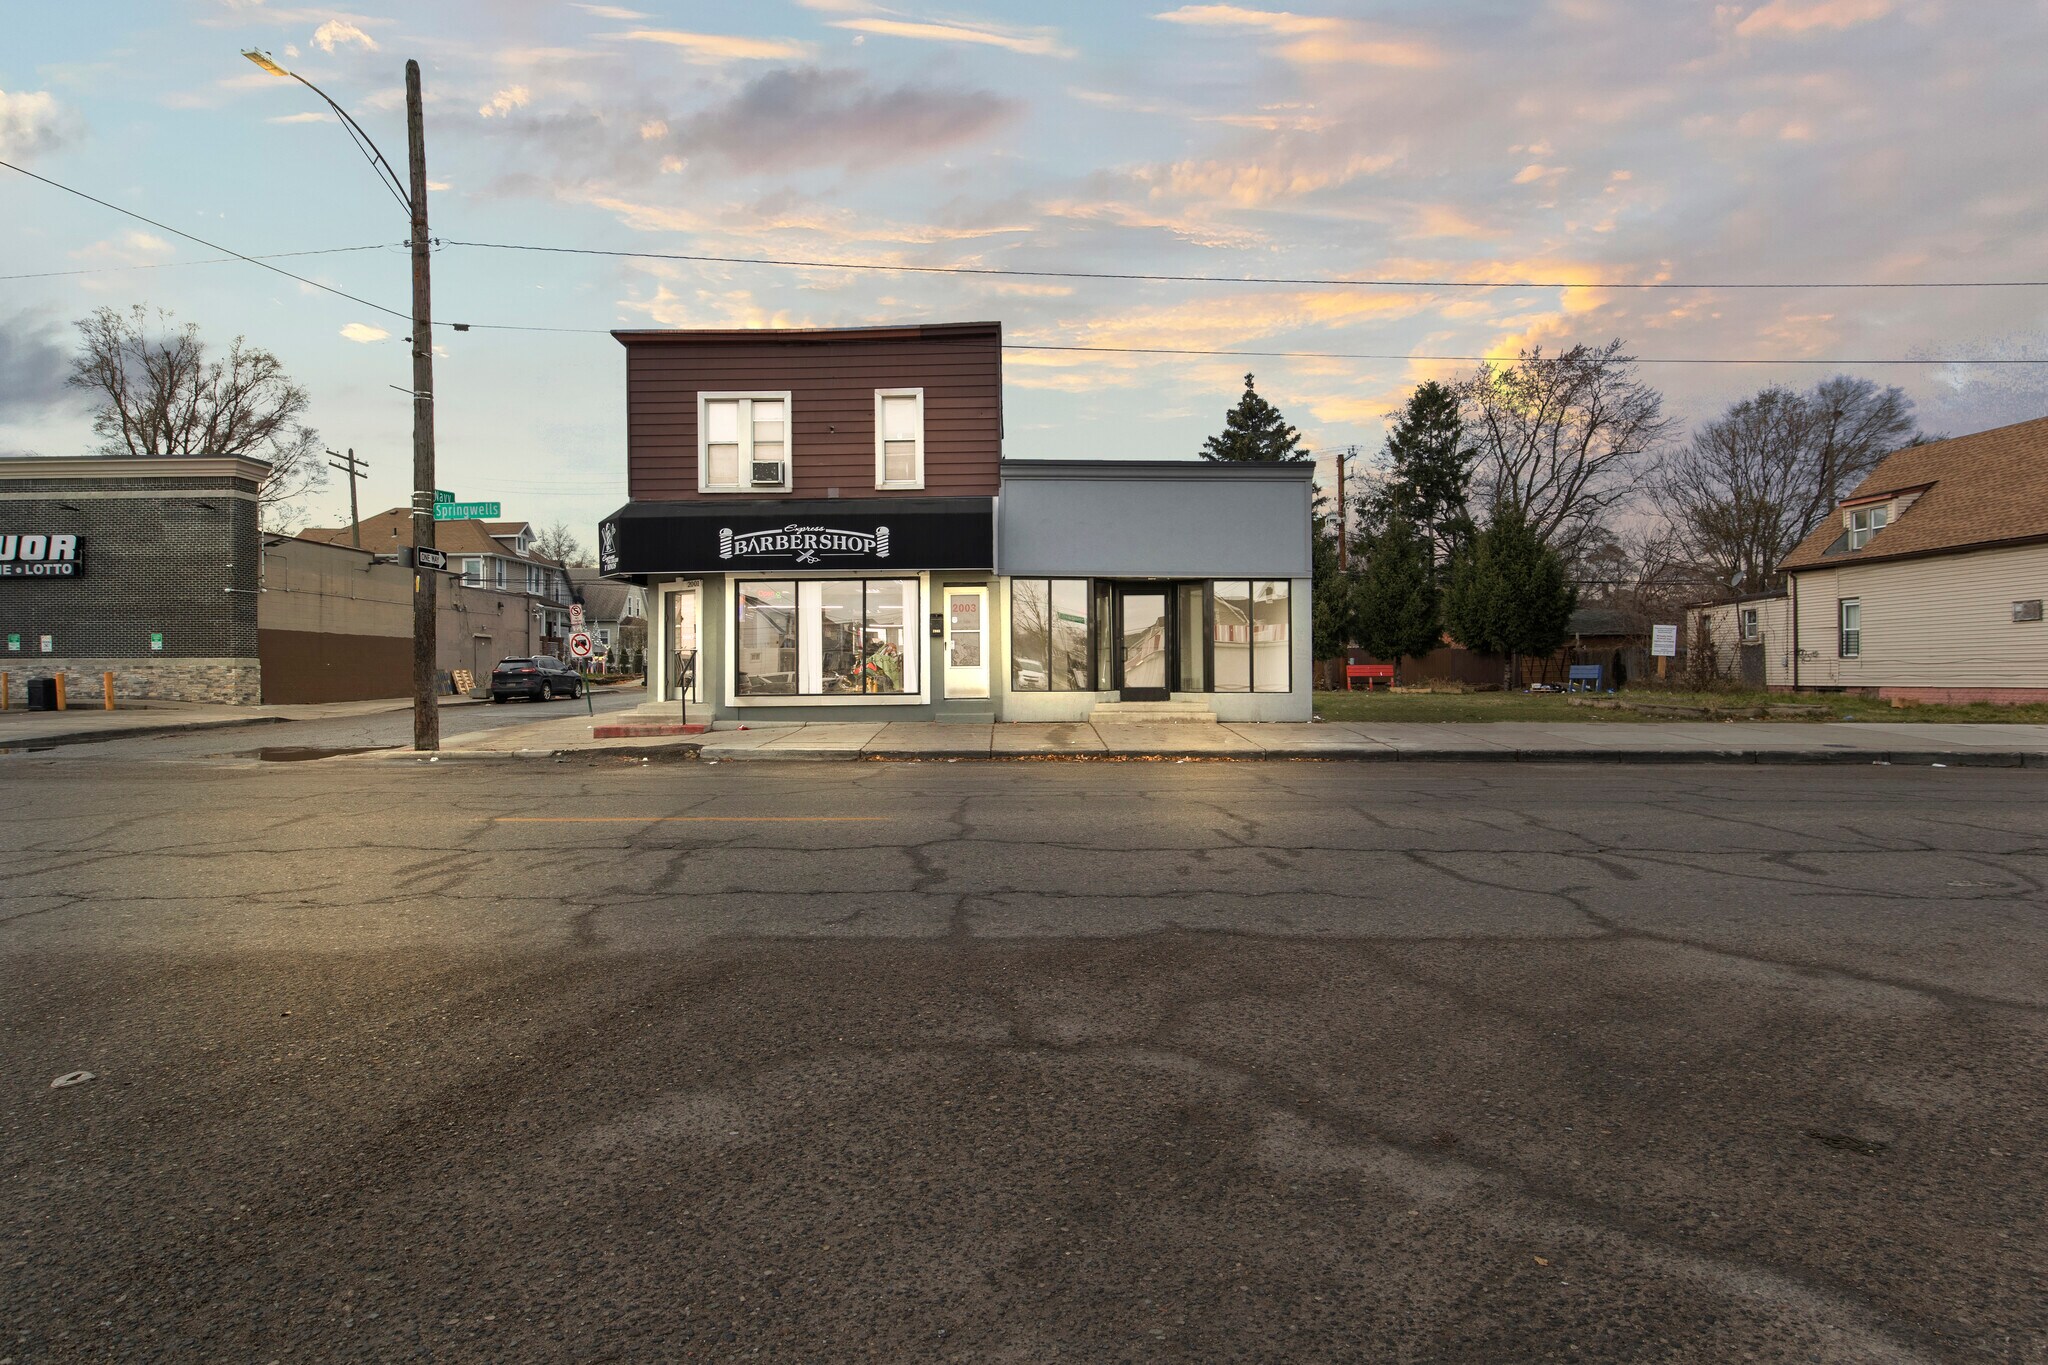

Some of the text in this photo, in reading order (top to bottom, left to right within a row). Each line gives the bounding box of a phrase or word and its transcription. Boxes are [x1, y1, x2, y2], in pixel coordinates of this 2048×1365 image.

[435, 490, 452, 503] Navy
[436, 503, 498, 519] Springwells
[784, 524, 825, 534] Express
[734, 534, 876, 555] BARBERSHOP
[422, 553, 431, 562] ONE
[0, 563, 72, 575] E LOTTO
[952, 604, 976, 613] 2003
